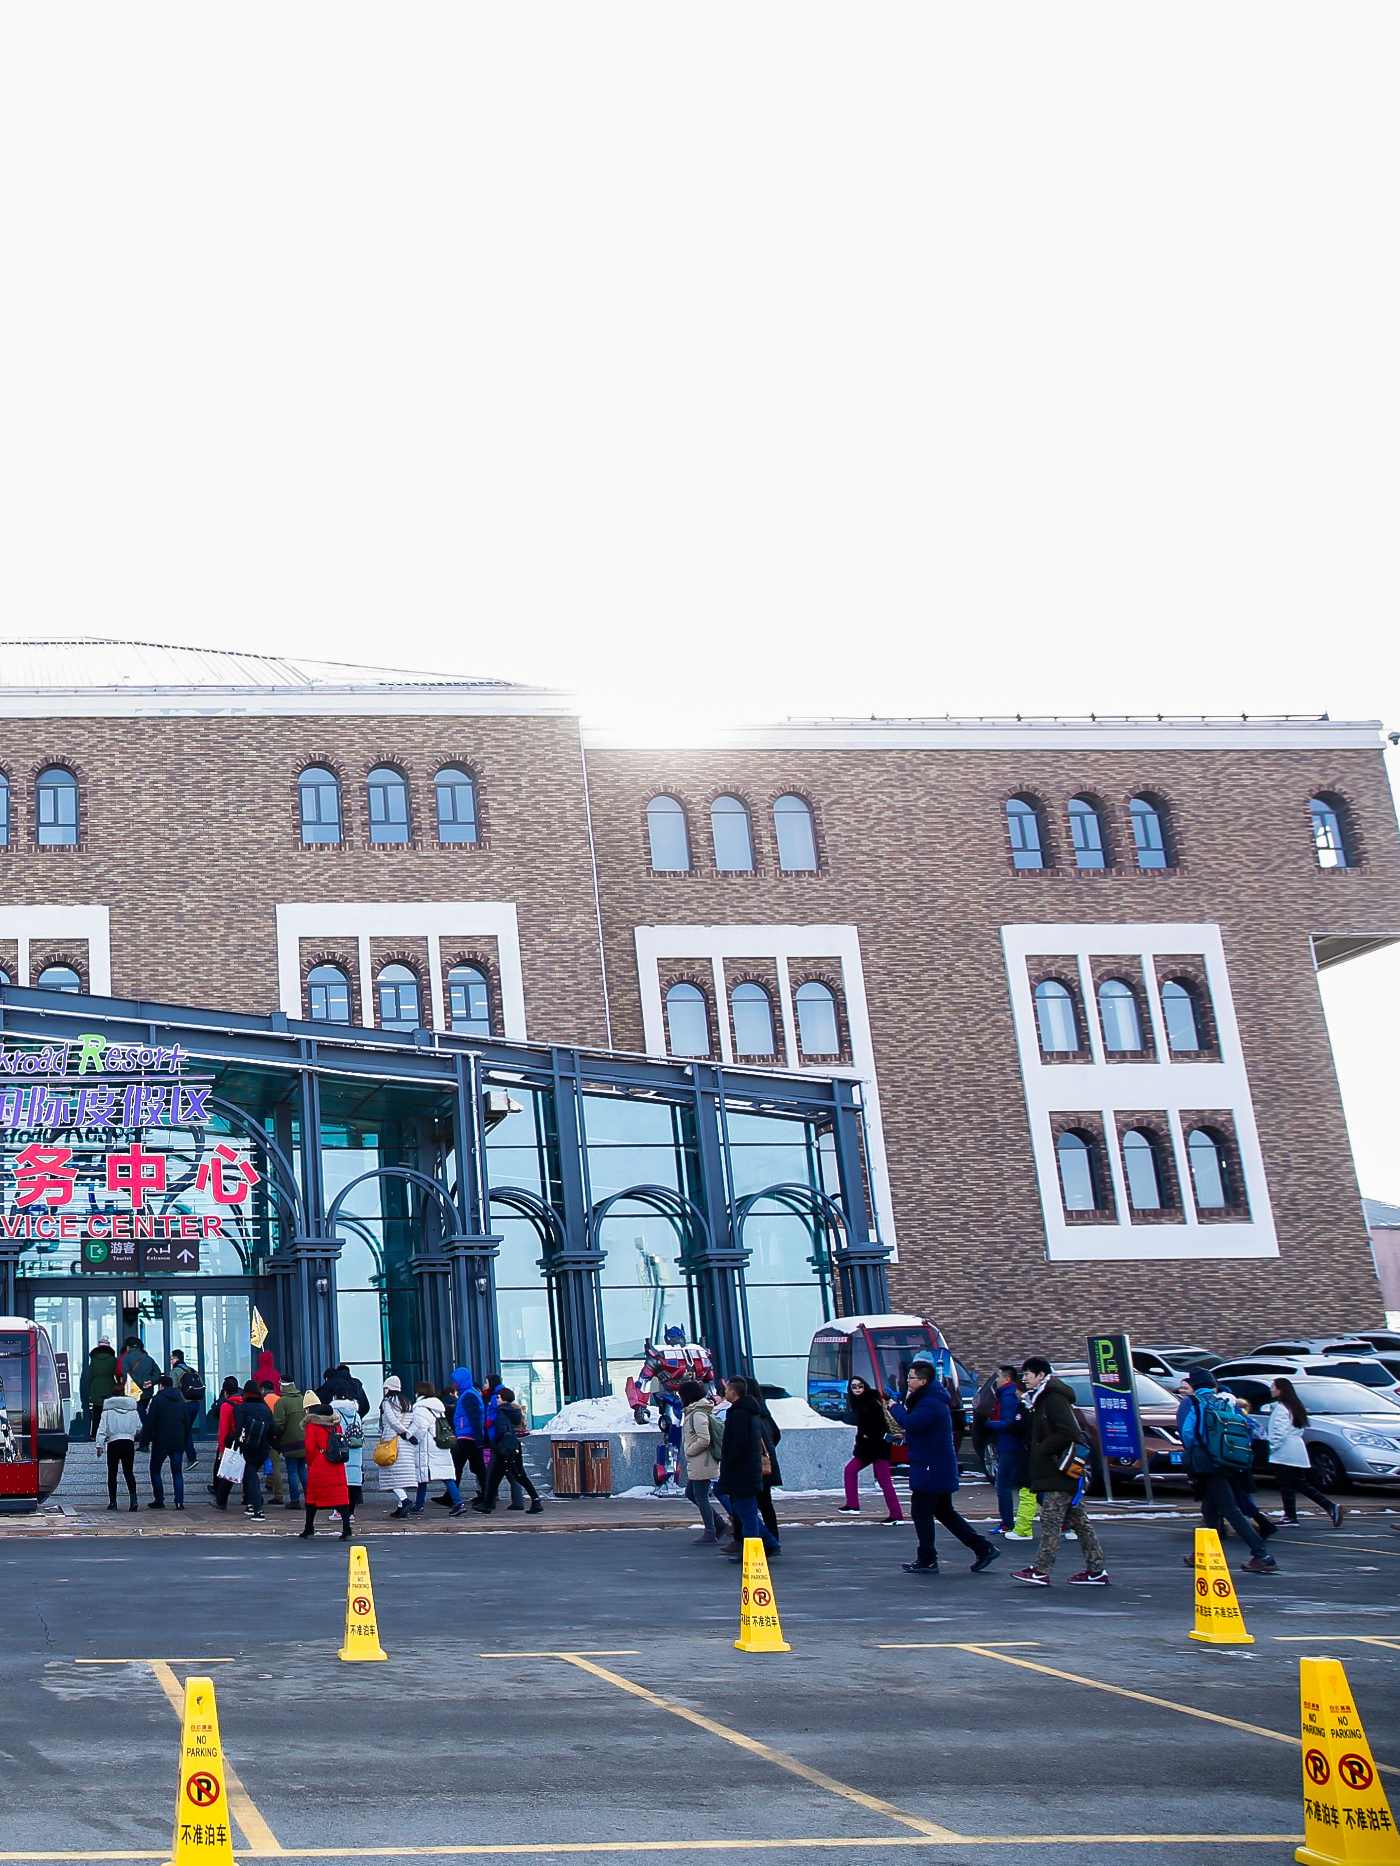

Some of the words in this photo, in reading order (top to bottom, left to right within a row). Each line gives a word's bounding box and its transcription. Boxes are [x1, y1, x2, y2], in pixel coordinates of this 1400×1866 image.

[78, 1034, 187, 1073] Resort
[87, 1215, 223, 1239] CENTER
[110, 1242, 135, 1254] 游客
[1098, 1339, 1114, 1374] P
[1213, 1606, 1240, 1618] 不准泊车
[752, 1615, 777, 1627] 不准泊车
[350, 1624, 376, 1636] 不准泊车
[1309, 1713, 1317, 1724] NO
[1337, 1716, 1349, 1727] NO
[1303, 1722, 1326, 1738] PARKING
[1330, 1728, 1362, 1740] PARKING
[196, 1735, 207, 1745] NO
[186, 1747, 218, 1758] PARKING
[1304, 1798, 1340, 1829] 不准泊车
[1342, 1807, 1392, 1832] 不准泊车
[181, 1823, 227, 1846] 不准泊车
